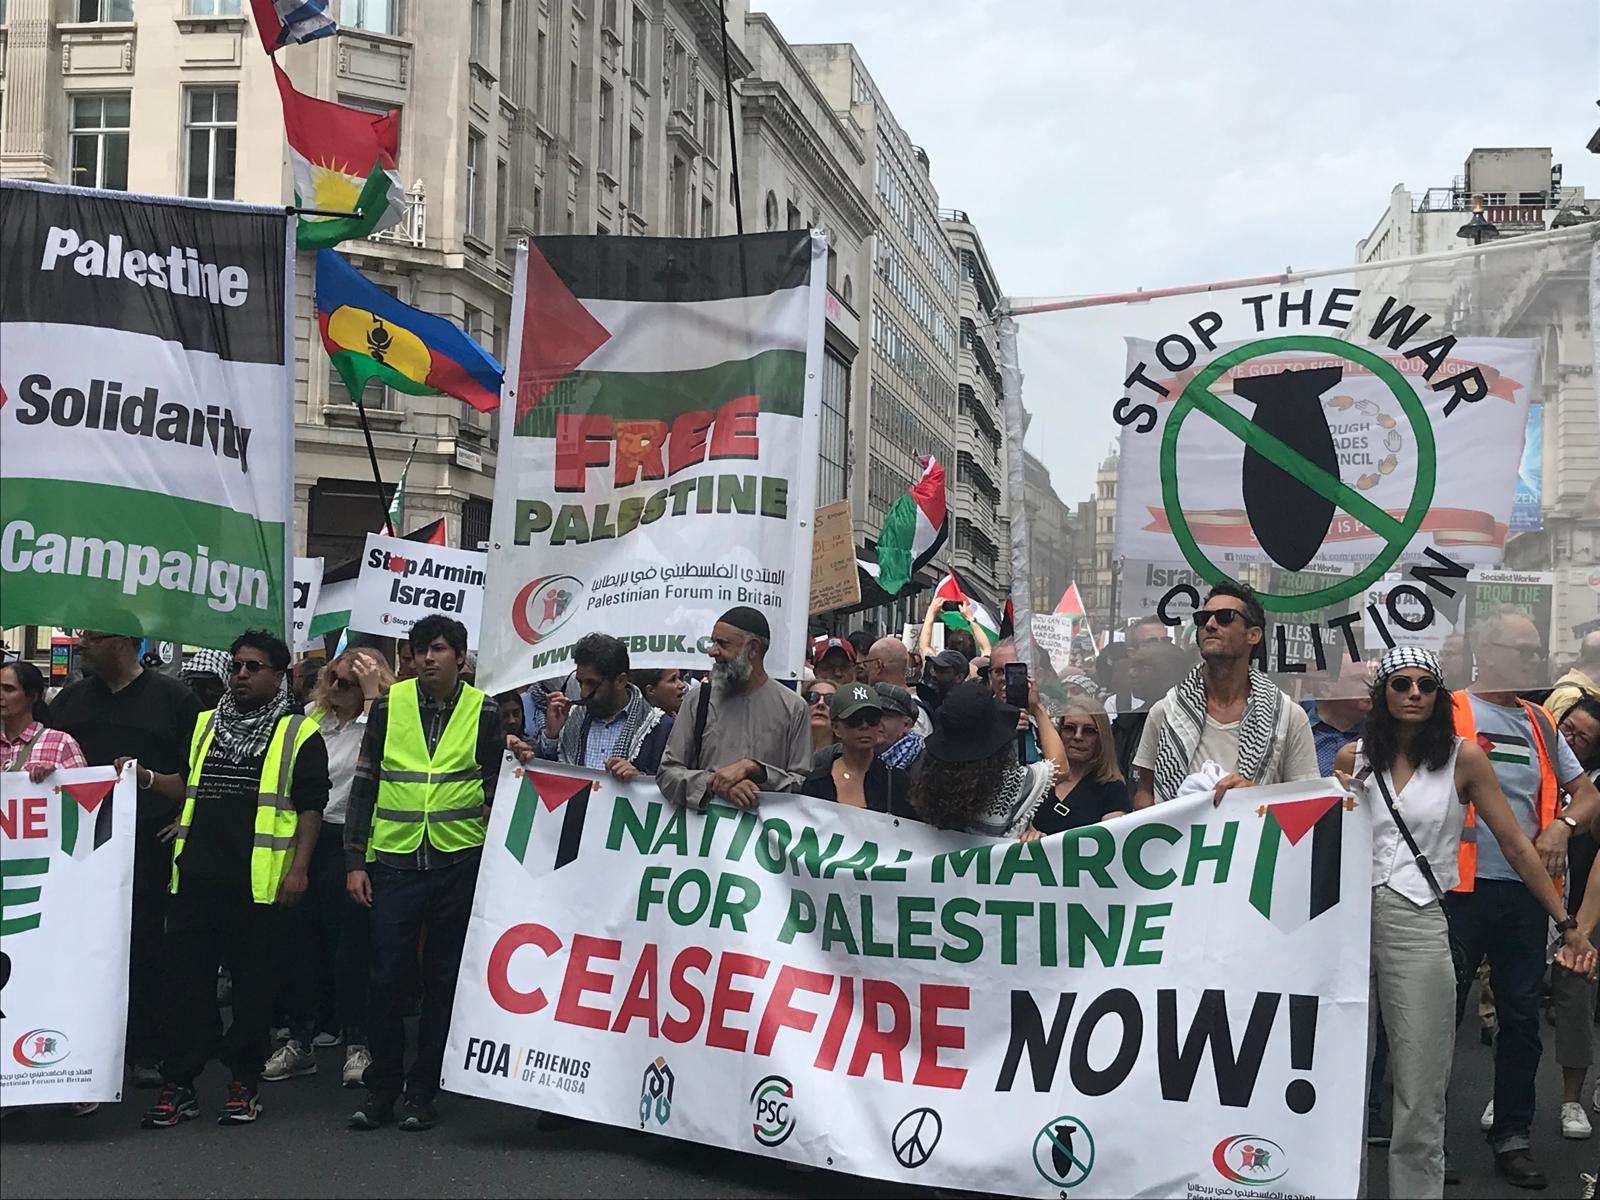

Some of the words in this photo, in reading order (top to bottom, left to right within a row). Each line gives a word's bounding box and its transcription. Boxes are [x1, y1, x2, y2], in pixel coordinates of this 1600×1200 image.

[41, 226, 249, 306] Palestine
[1113, 311, 1223, 434] STOP
[1242, 288, 1361, 332] THE
[1367, 296, 1488, 417] WAR
[16, 374, 252, 474] Solidarity
[554, 394, 761, 493] FREE
[514, 474, 789, 546] PALESTINE
[1338, 519, 1350, 533] IS
[1, 520, 269, 612] Campaign
[630, 565, 658, 586] في
[1475, 584, 1513, 600] FROM
[1518, 586, 1541, 602] THE
[1480, 572, 1513, 582] Socialist
[1513, 573, 1541, 583] Worker
[389, 578, 466, 613] Israel
[587, 586, 660, 610] Palestinian
[665, 585, 713, 600] Forum
[718, 584, 731, 601] in
[737, 586, 782, 608] Britain
[1157, 546, 1470, 673] CLITION
[605, 796, 914, 883] NATIONAL
[930, 821, 1240, 890] MARCH
[636, 866, 762, 932] FOR
[777, 888, 1173, 968] PALESTINE
[487, 922, 970, 1090] CEASEFIRE
[995, 987, 1319, 1115] NOW!
[463, 1037, 511, 1078] FOA
[522, 1069, 537, 1083] OF
[538, 1072, 586, 1094] AL-AQSA
[525, 1048, 591, 1079] FRIENDS
[756, 1098, 789, 1126] PSC
